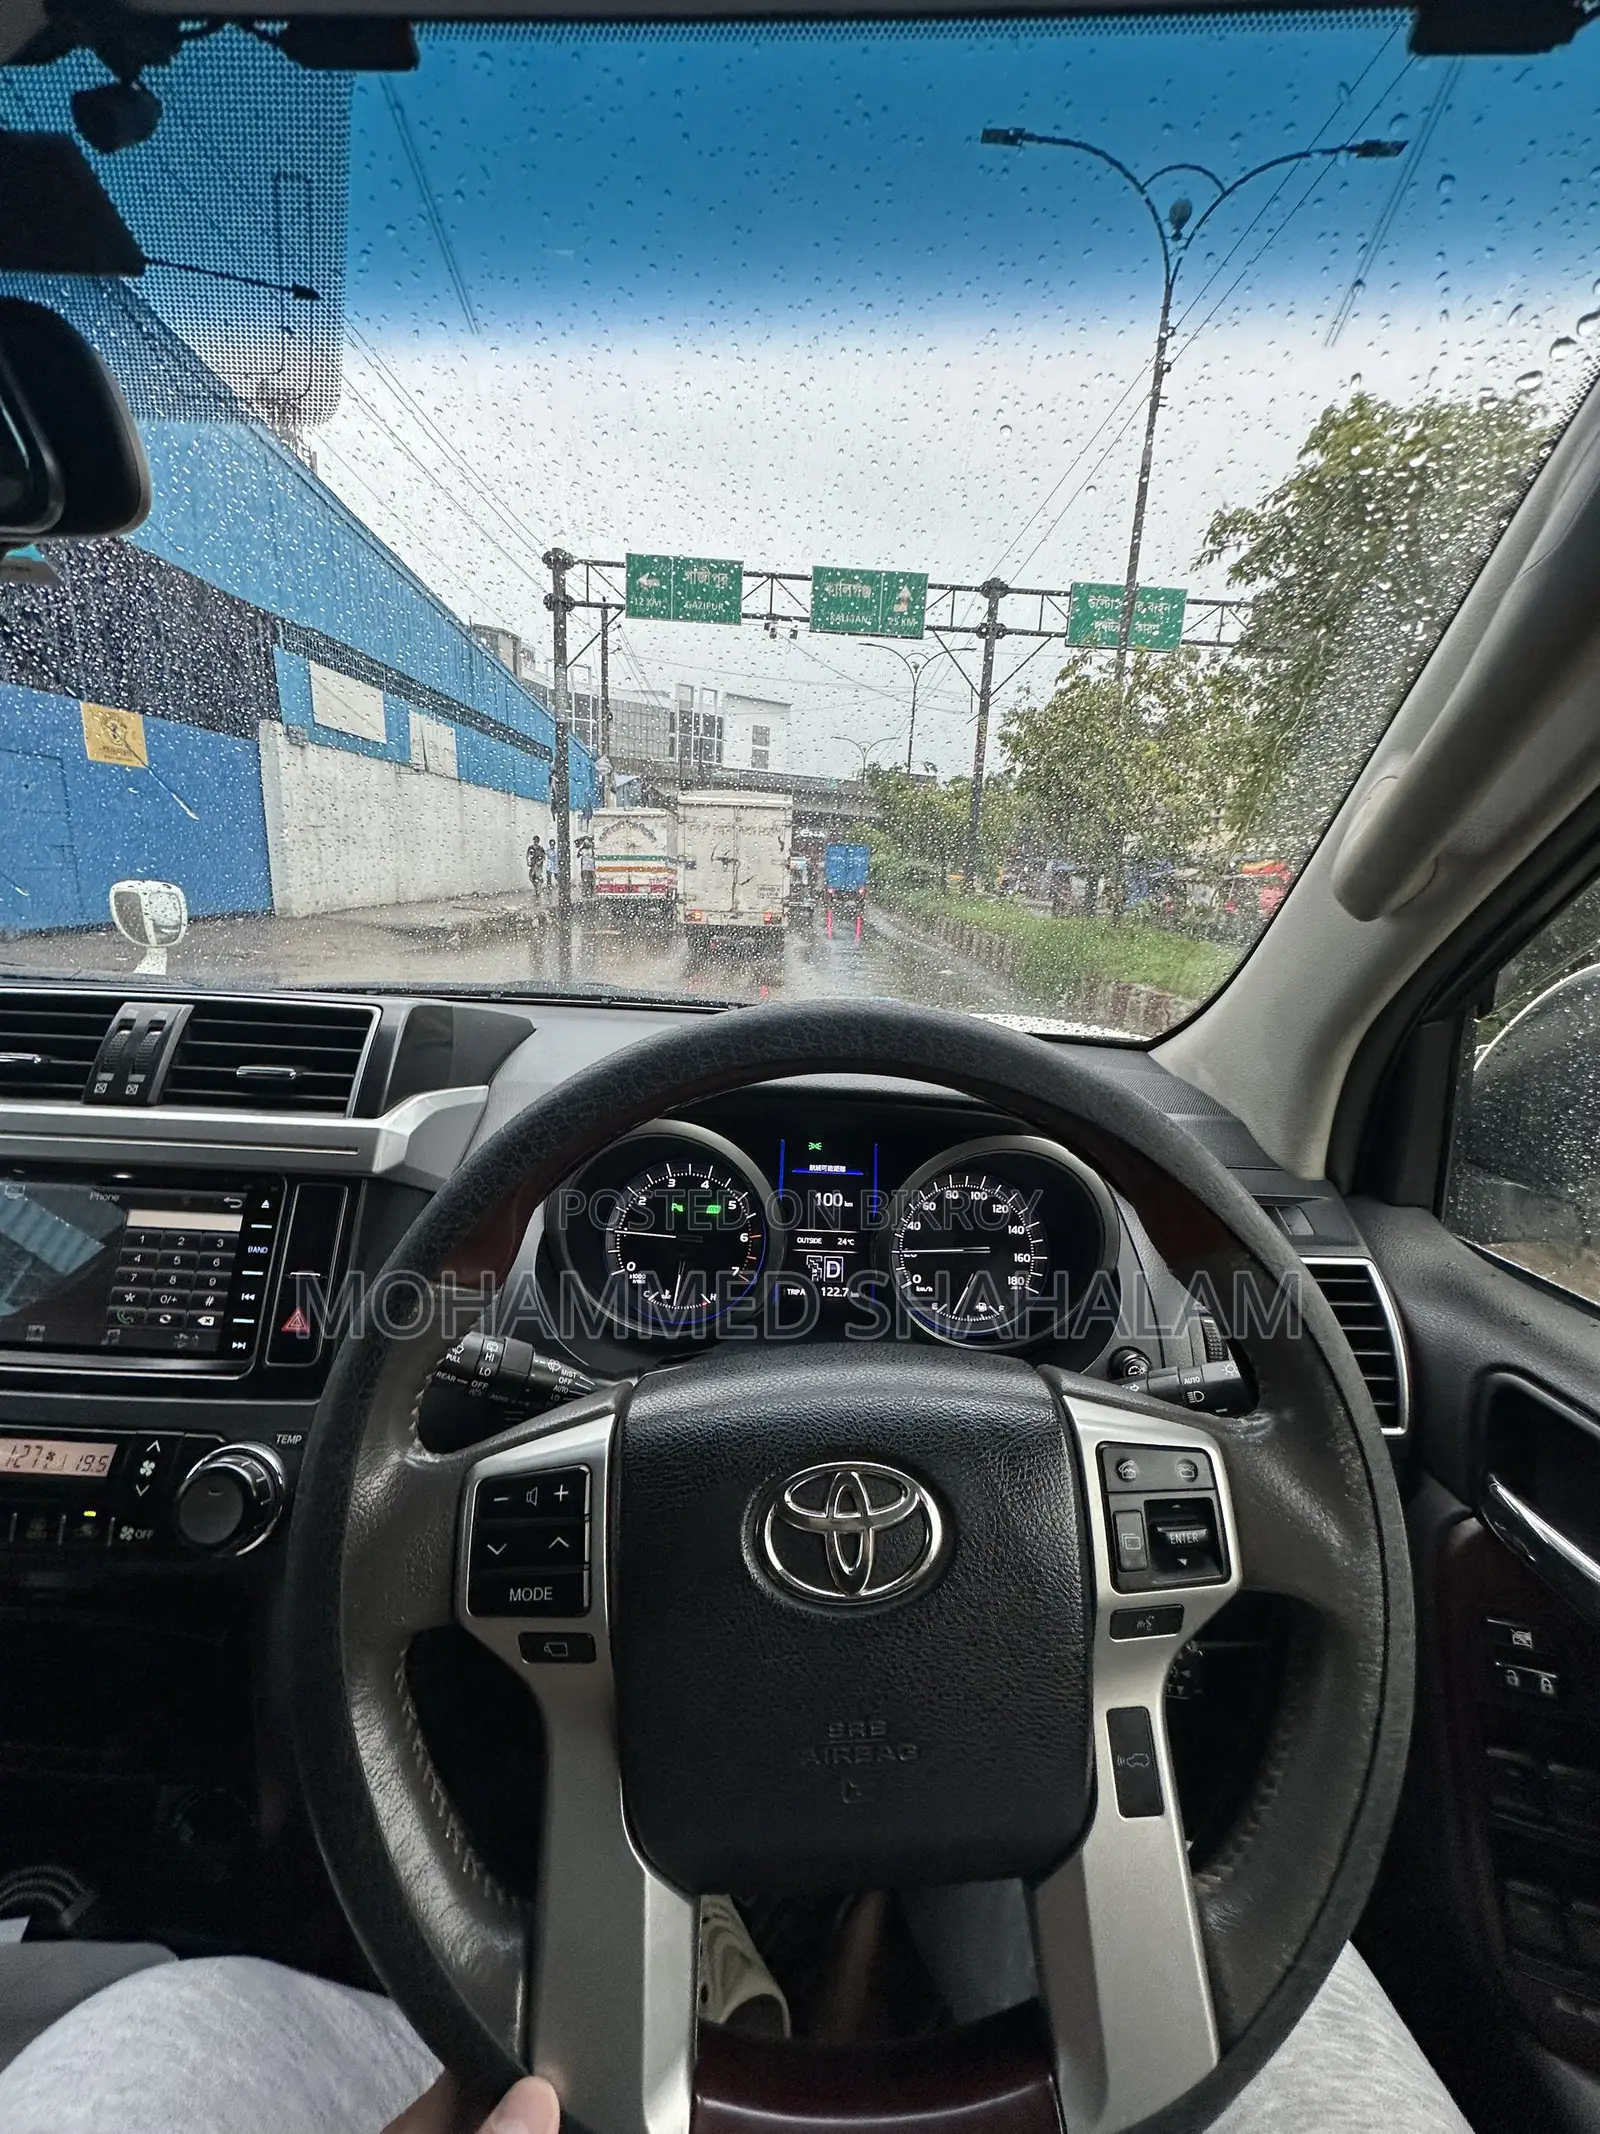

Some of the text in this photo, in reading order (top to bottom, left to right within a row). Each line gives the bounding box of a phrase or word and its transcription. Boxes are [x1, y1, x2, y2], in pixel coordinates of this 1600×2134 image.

[634, 597, 661, 607] 12 KM
[685, 601, 724, 611] GAZIPUR
[888, 618, 917, 627] 25 KM
[667, 1179, 676, 1188] 3
[701, 1179, 710, 1189] 4
[815, 1192, 843, 1207] 100
[945, 1190, 959, 1200] 80
[970, 1191, 988, 1201] 100
[638, 1197, 647, 1206] 2
[728, 1200, 737, 1210] 5
[922, 1202, 936, 1212] 60
[992, 1204, 1009, 1214] 120
[907, 1221, 921, 1231] 40
[1008, 1225, 1025, 1235] 140
[138, 1235, 224, 1248] 1 2 3
[740, 1233, 749, 1243] 6
[796, 1236, 823, 1245] OUTSIDE
[133, 1254, 220, 1267] 4 5 6
[1014, 1253, 1031, 1263] 160
[626, 1262, 636, 1271] 0
[731, 1266, 740, 1276] 7
[826, 1260, 841, 1279] D
[129, 1272, 217, 1286] 7 8 9
[912, 1274, 922, 1284] 0
[1007, 1276, 1025, 1286] 180
[643, 1290, 650, 1298] C
[821, 1286, 849, 1297] 122.7
[709, 1293, 717, 1301] H
[446, 1353, 461, 1364] PULL
[485, 1353, 495, 1362] HI
[435, 1371, 456, 1382] REAR
[479, 1367, 491, 1377] LO
[560, 1368, 578, 1379] MIST
[471, 1380, 489, 1390] OFF
[558, 1377, 572, 1385] OFF
[1184, 1376, 1200, 1385] AUTO
[553, 1385, 568, 1394] AUTO
[276, 1433, 302, 1445] TEMP
[75, 1455, 109, 1473] 19.5
[135, 1530, 154, 1540] OFF
[1169, 1531, 1199, 1545] ENTER
[509, 1586, 553, 1602] MODE
